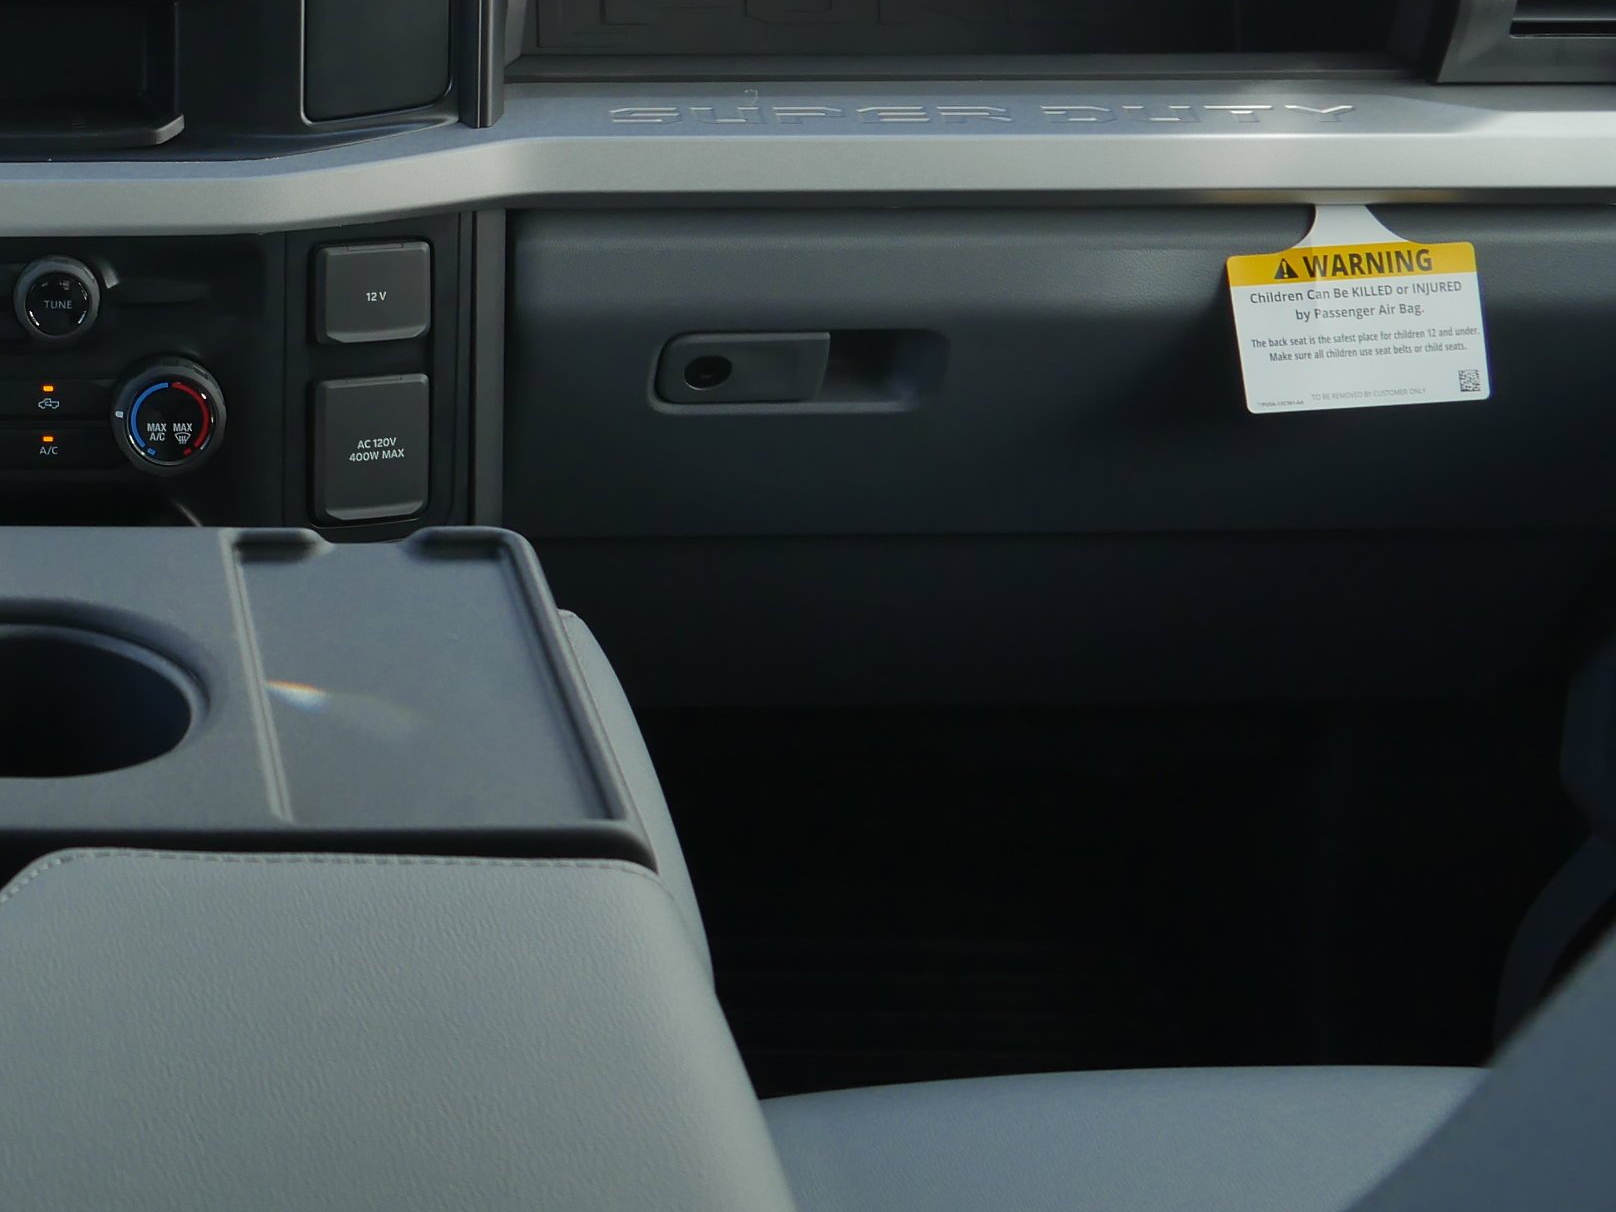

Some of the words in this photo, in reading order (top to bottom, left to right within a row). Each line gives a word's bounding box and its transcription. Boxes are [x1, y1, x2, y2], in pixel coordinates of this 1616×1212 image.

[607, 103, 1015, 126] SUPER
[1039, 103, 1355, 125] DUTY
[1303, 249, 1433, 278] WARNING
[366, 292, 377, 302] 12
[378, 292, 387, 302] V
[1250, 291, 1304, 304] Children
[1307, 289, 1330, 300] Can
[1334, 287, 1349, 299] Be
[1352, 285, 1393, 298] KILLED
[1396, 286, 1409, 295] or
[1412, 281, 1462, 295] INJURED
[44, 299, 73, 309] TUNE
[1295, 309, 1311, 323] by
[1315, 305, 1375, 320] Passenger
[1379, 304, 1396, 315] Air
[1399, 303, 1425, 316] Bag.
[1251, 339, 1267, 348] The
[1269, 337, 1288, 347] back
[1290, 337, 1308, 346] seat
[1309, 336, 1316, 344] is
[1318, 335, 1331, 344] the
[1333, 333, 1356, 343] safest
[1358, 332, 1379, 343] place
[1380, 331, 1392, 340] for
[1394, 329, 1425, 340] children
[1428, 329, 1436, 337] 12
[1438, 327, 1453, 337] and
[1455, 326, 1480, 336] under.
[1269, 352, 1292, 362] Make
[1294, 352, 1312, 360] sure
[1314, 349, 1325, 359] all
[1326, 347, 1358, 358] children
[1360, 348, 1373, 356] use
[1375, 346, 1391, 356] seat
[1393, 345, 1412, 354] belts
[1414, 345, 1423, 353] or
[1424, 343, 1443, 353] child
[1445, 342, 1468, 351] seats.
[1373, 389, 1408, 397] CUSTOMER
[147, 423, 167, 432] MAX
[172, 423, 193, 432] MAX
[149, 432, 165, 441] A/C
[357, 439, 372, 449] AC
[372, 437, 397, 449] 120V
[39, 445, 59, 456] A/C
[349, 451, 379, 462] 400W
[382, 448, 405, 459] MAX
